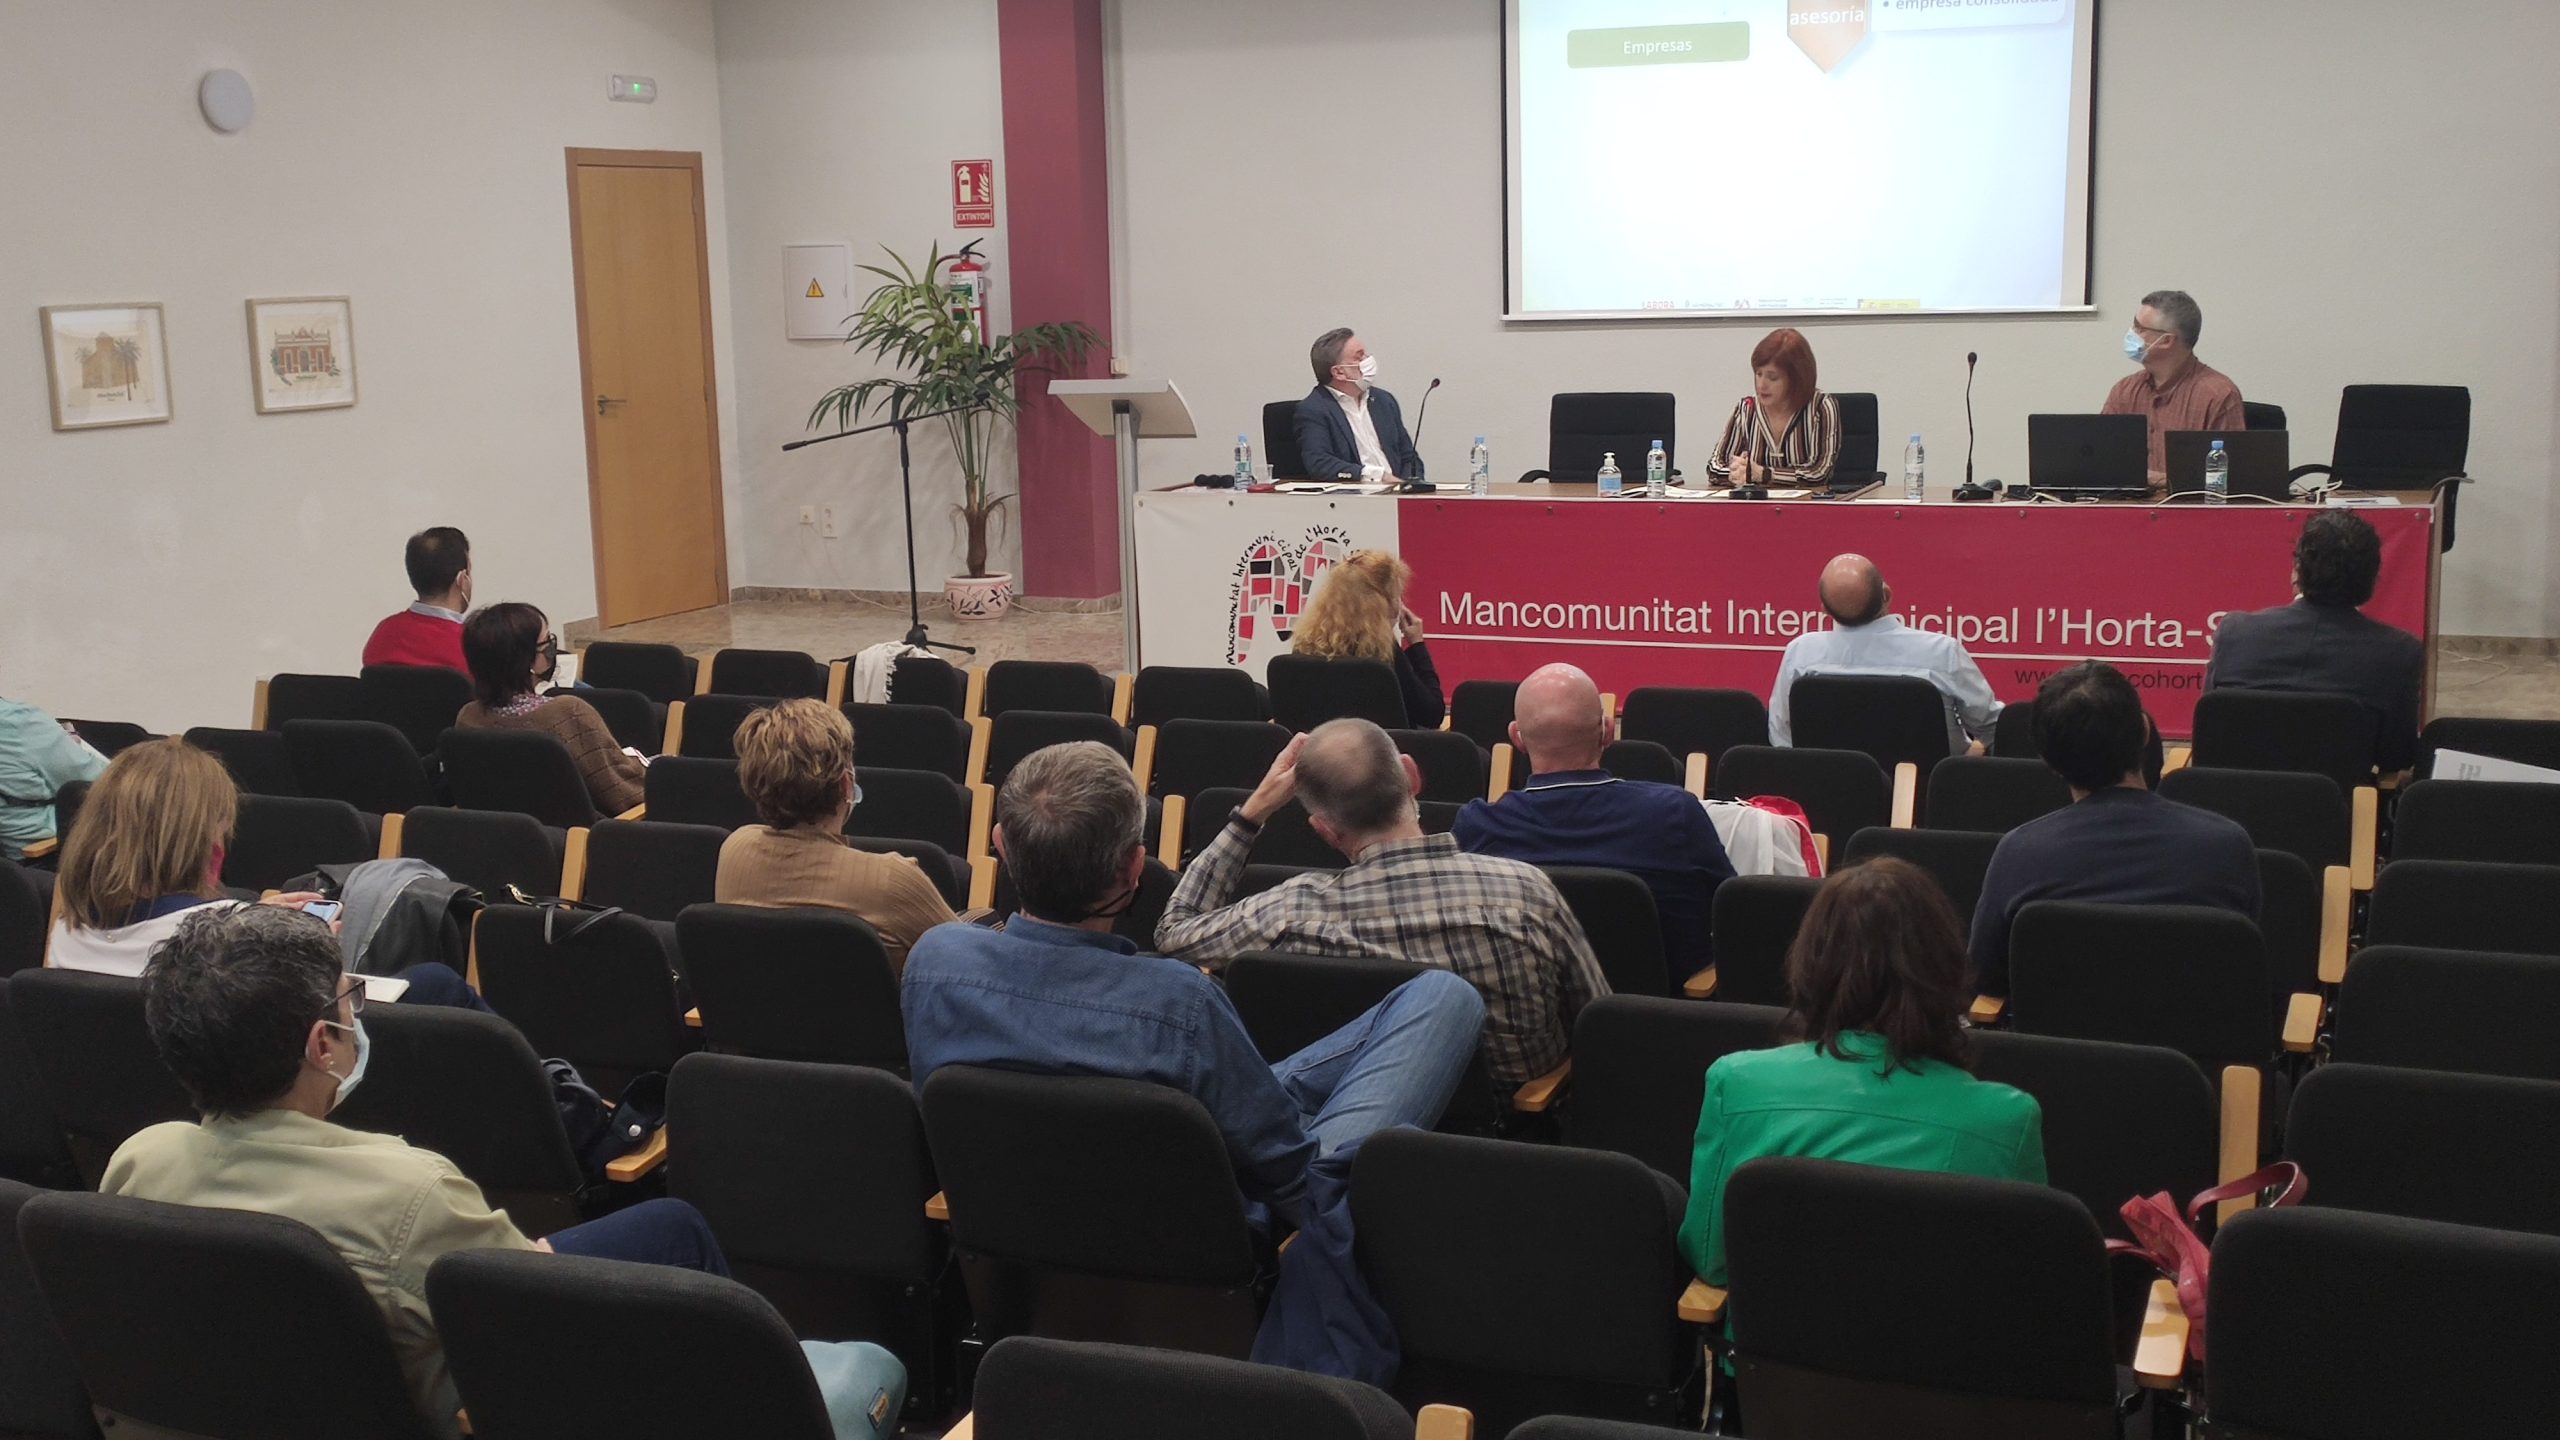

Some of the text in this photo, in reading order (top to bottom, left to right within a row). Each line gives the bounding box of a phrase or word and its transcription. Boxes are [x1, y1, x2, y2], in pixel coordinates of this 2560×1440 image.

[1789, 5, 1864, 25] asesoría
[1623, 40, 1693, 56] Empresas
[957, 212, 990, 221] EXTINTOR
[1295, 543, 1307, 559] de
[1440, 591, 2228, 648] Mancomunitat Intericipal l'Horta-S
